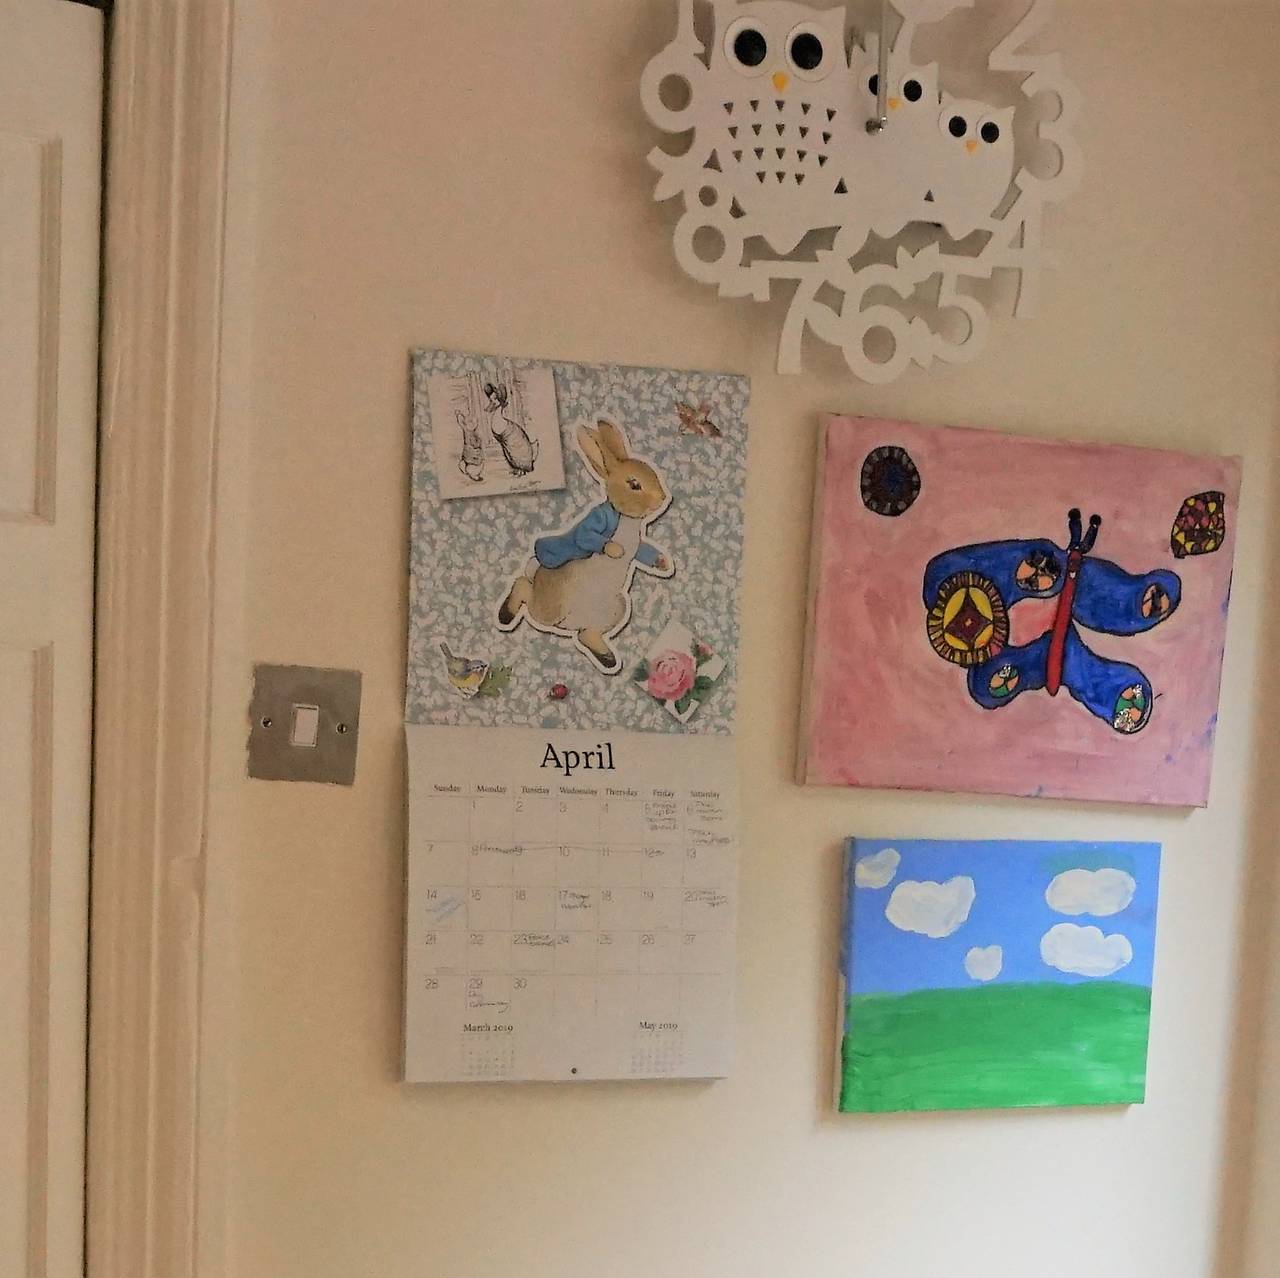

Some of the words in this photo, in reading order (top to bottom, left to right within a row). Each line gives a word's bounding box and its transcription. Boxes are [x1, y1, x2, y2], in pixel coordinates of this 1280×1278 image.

[1015, 70, 1084, 202] 3
[842, 264, 916, 384] 6
[540, 743, 615, 776] April
[433, 784, 462, 793] Sunday
[476, 785, 507, 794] Monday
[521, 786, 550, 795] Tuesday
[559, 786, 598, 796] Wednesday
[606, 788, 638, 797] Thursday
[653, 789, 675, 798] Friday
[690, 790, 721, 799] Saturday
[463, 1024, 491, 1032] March
[494, 1025, 514, 1033] 2019
[639, 1021, 656, 1031] May
